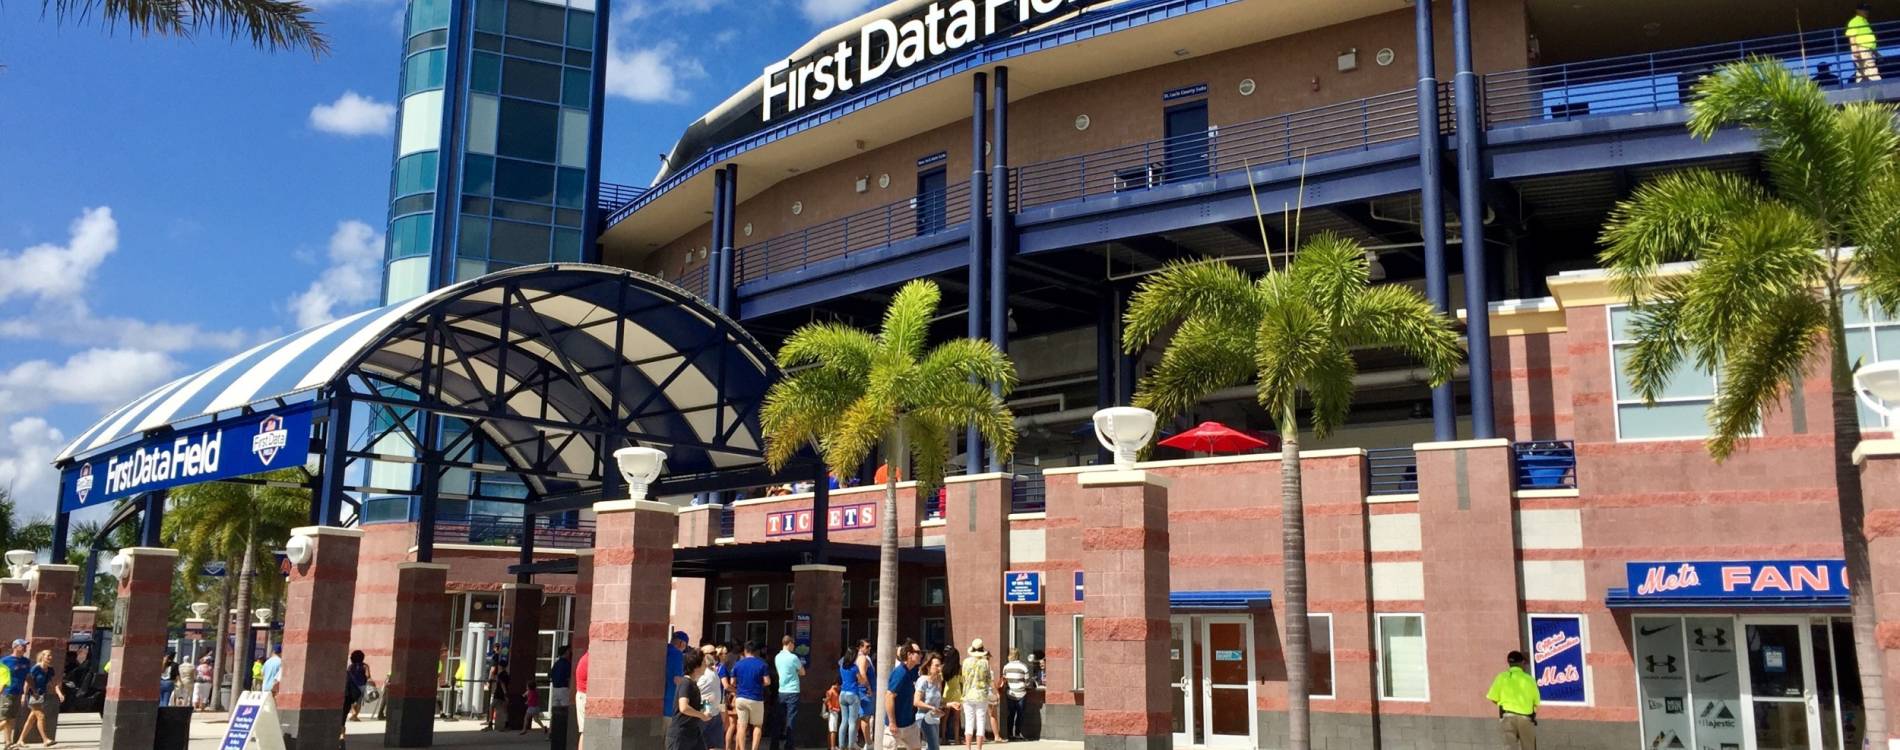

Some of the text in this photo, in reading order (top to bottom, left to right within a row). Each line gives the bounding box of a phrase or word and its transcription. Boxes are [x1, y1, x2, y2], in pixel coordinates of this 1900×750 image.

[763, 41, 853, 122] First
[860, 0, 975, 84] Data
[105, 428, 222, 495] First Data Field
[769, 507, 873, 532] TICETS
[1637, 563, 1699, 595] Mets
[1721, 565, 1830, 592] FAN
[1537, 664, 1579, 686] Mets
